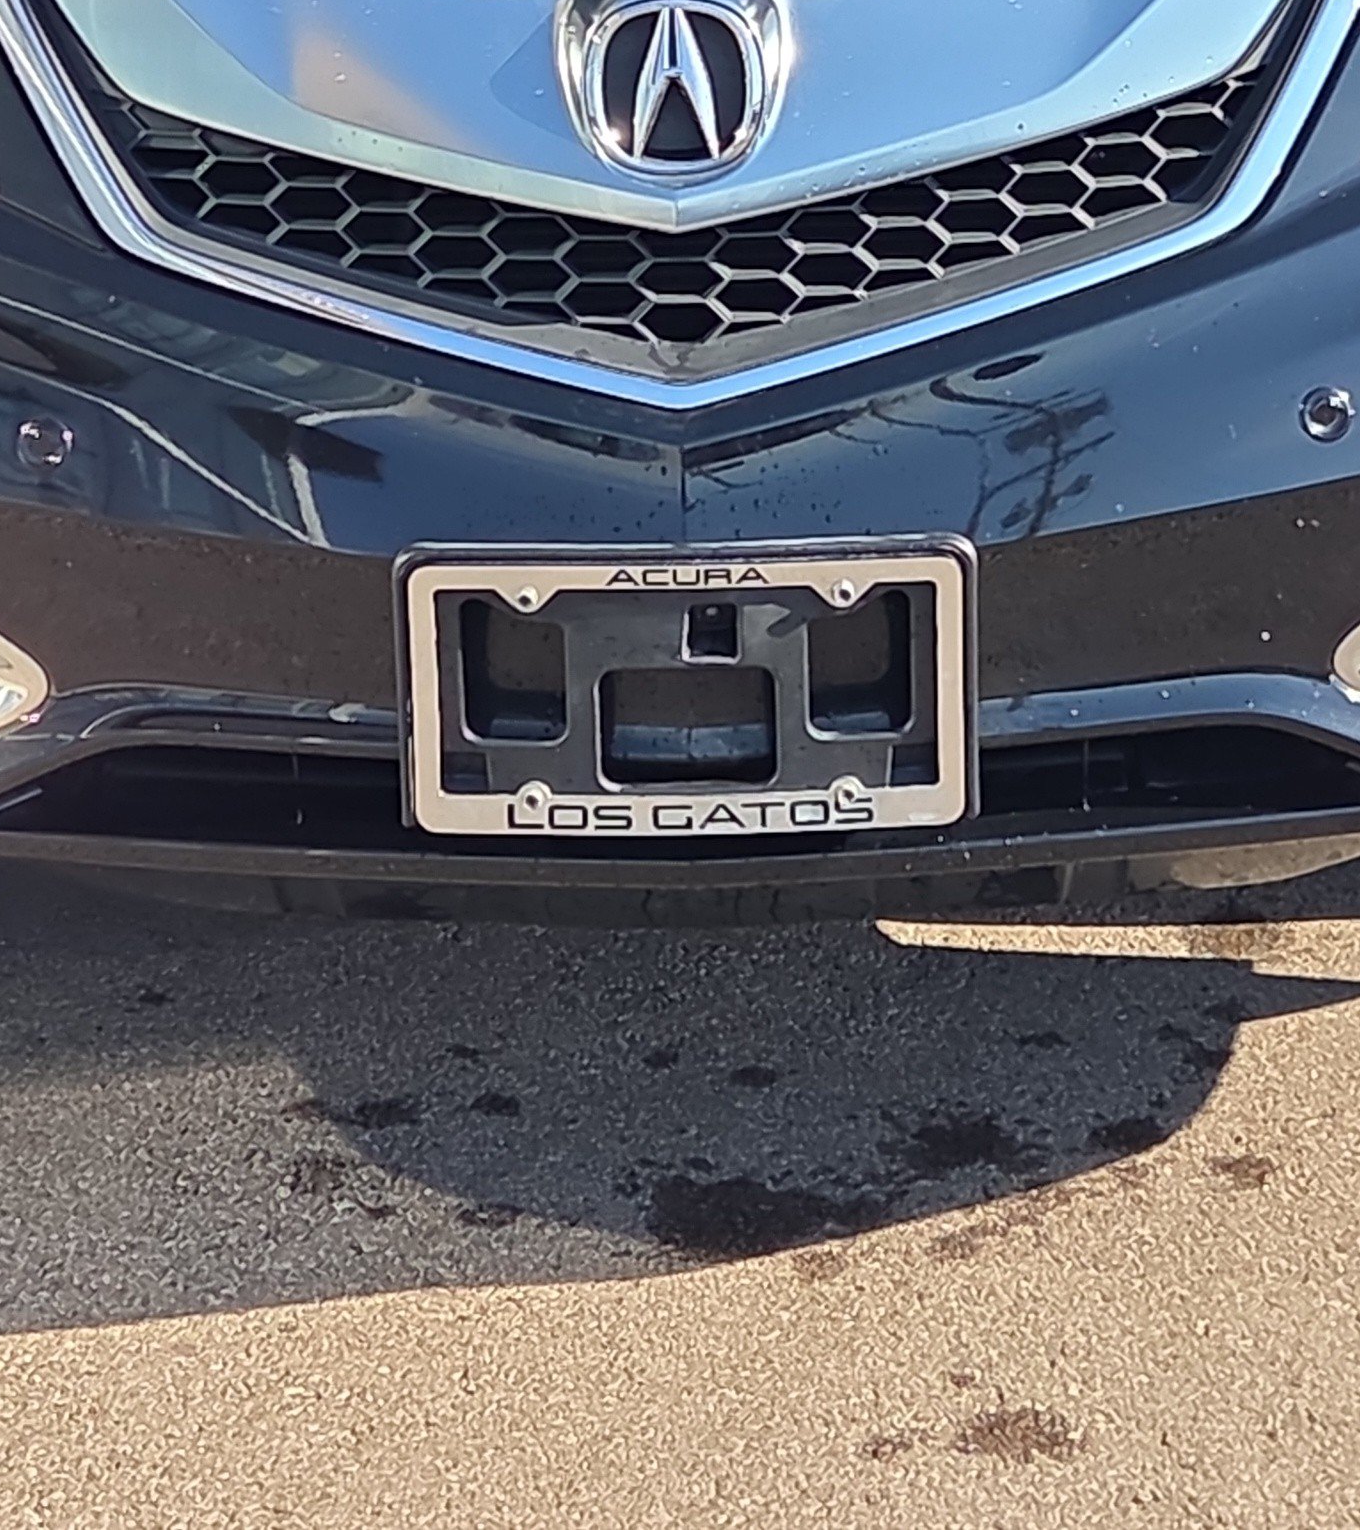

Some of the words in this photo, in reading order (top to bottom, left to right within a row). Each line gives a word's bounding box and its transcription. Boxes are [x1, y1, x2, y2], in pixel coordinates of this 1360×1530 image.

[605, 567, 770, 586] ACURA
[507, 803, 633, 830] LOS
[652, 787, 873, 830] GATOS
